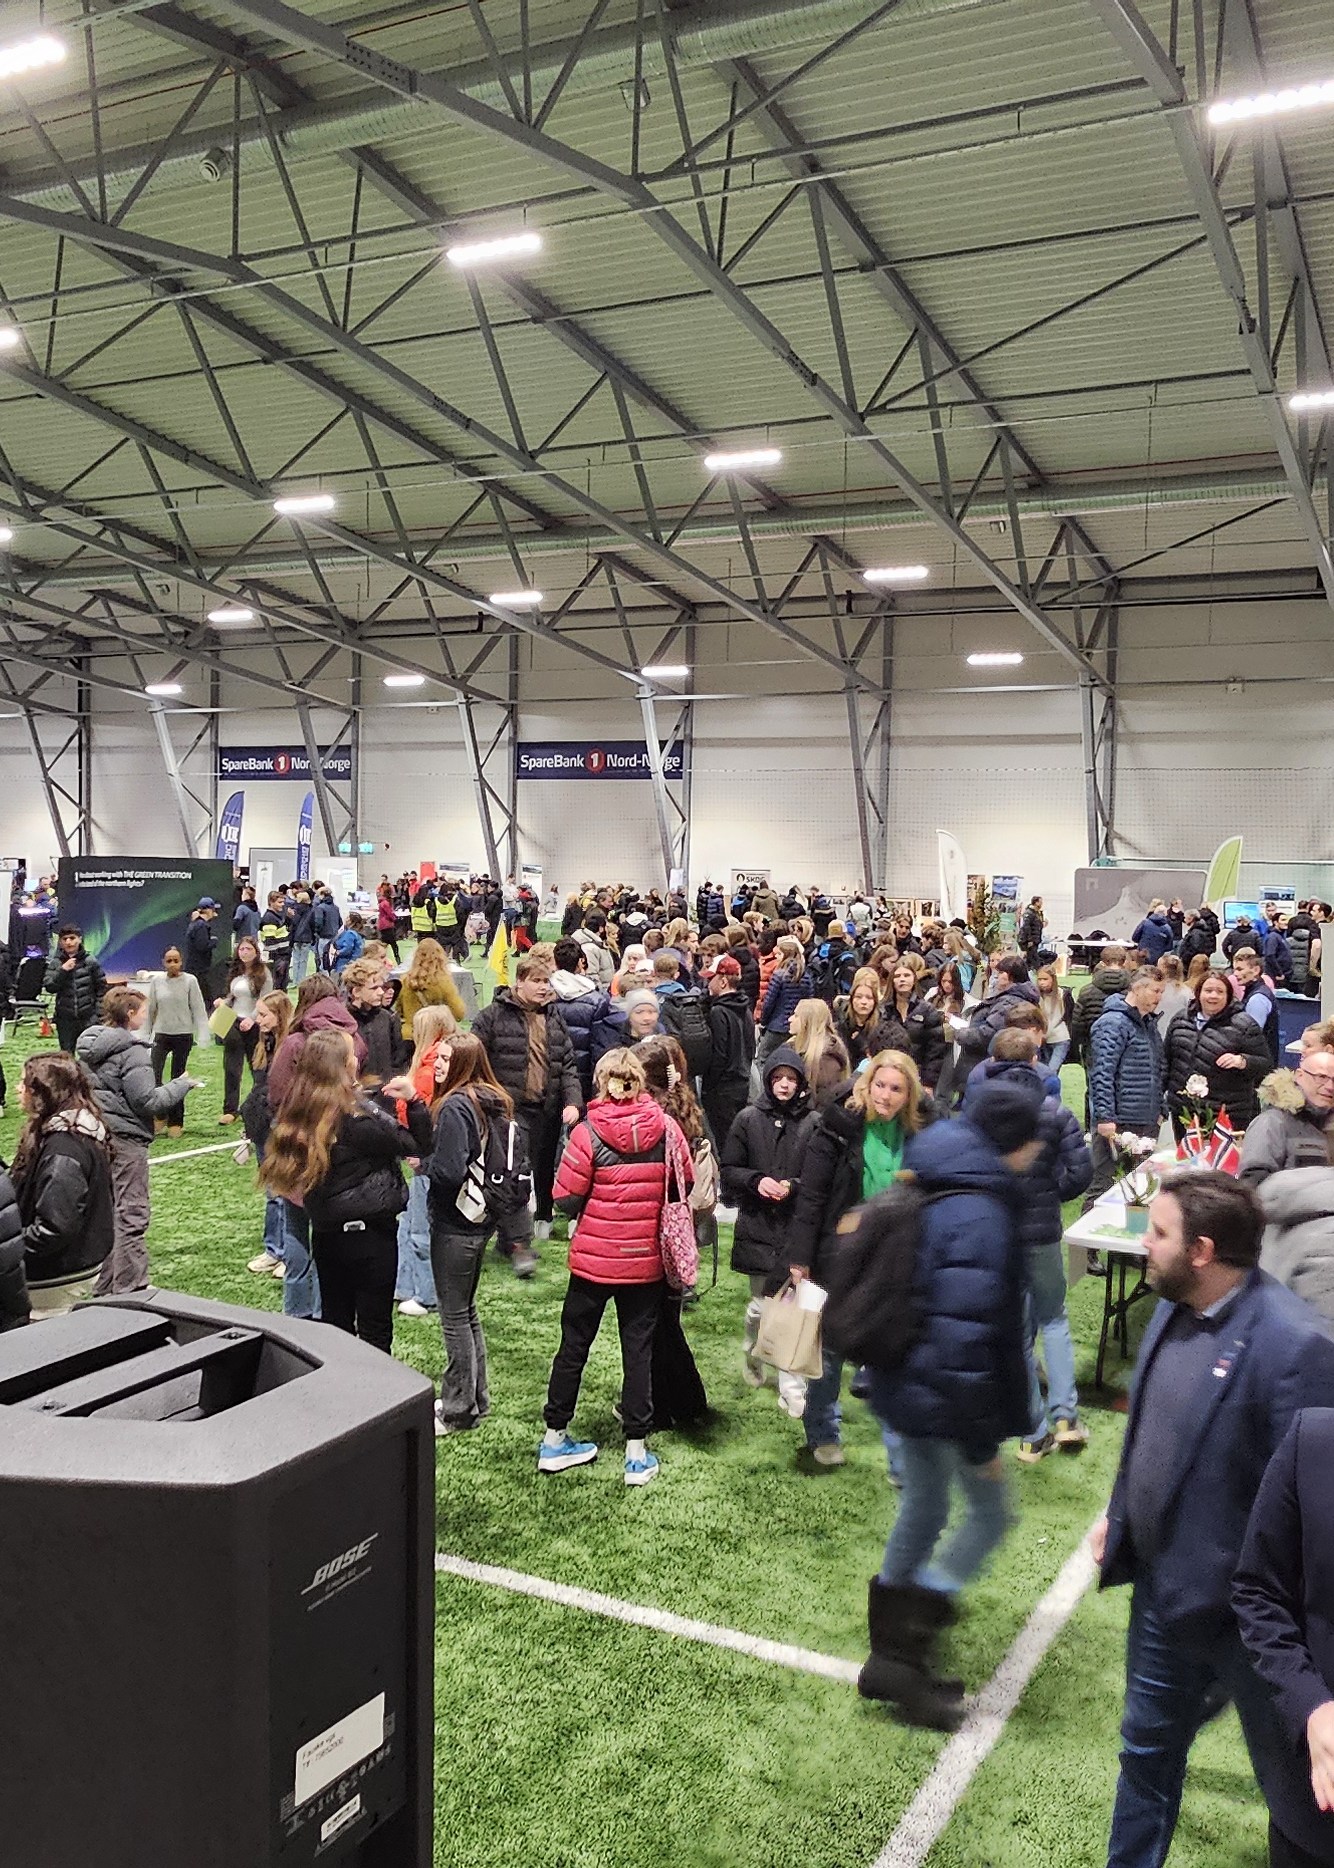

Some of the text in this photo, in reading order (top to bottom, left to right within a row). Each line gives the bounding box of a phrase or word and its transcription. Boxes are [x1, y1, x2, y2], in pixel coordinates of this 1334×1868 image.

[221, 757, 274, 772] SpareBank
[291, 757, 351, 772] Nororge
[521, 753, 585, 771] SpareBank
[606, 753, 681, 772] Nord-Nge
[134, 871, 154, 879] GREEN
[154, 871, 192, 879] TRANSITION
[308, 1538, 375, 1589] BOSE
